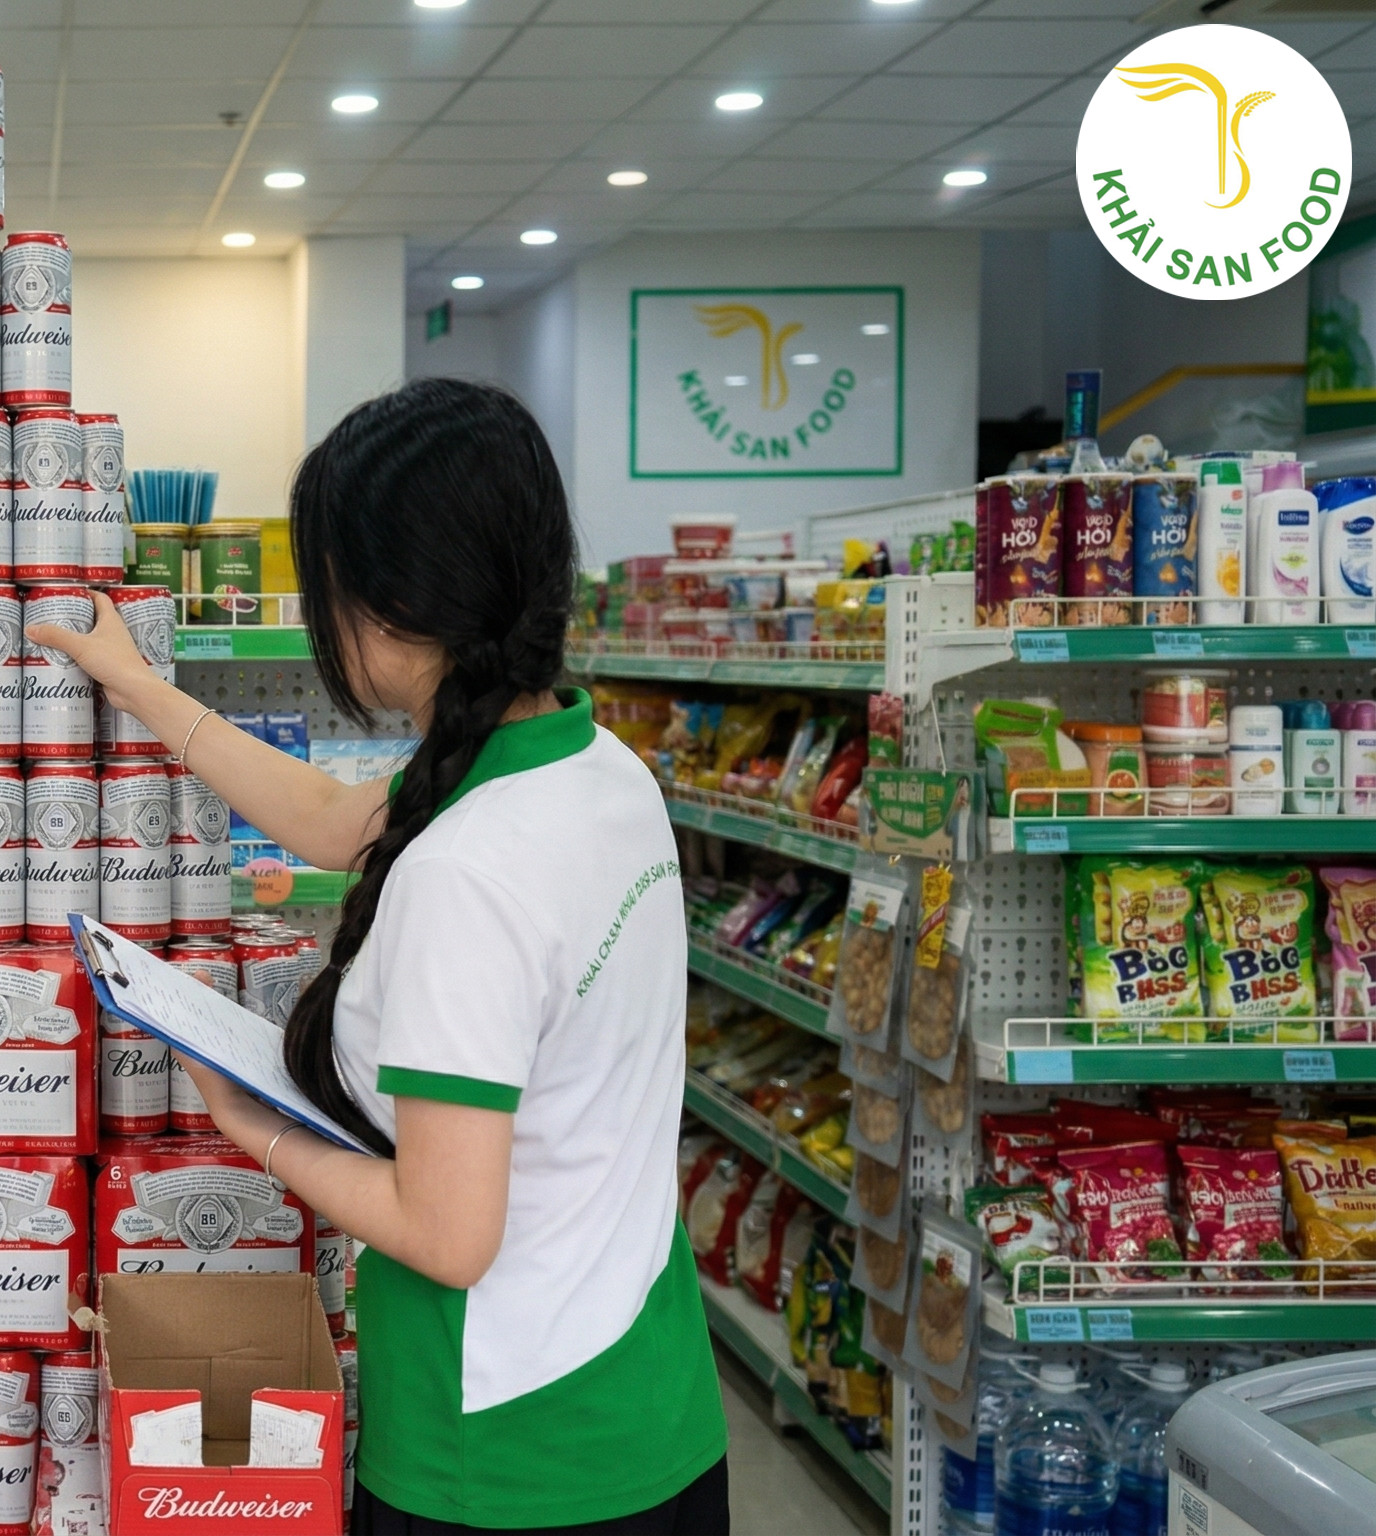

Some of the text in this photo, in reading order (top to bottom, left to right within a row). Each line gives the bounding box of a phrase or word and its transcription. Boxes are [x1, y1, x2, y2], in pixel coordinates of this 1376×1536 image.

[730, 431, 791, 460] SAN
[796, 367, 857, 449] FOOD
[110, 1165, 122, 1181] 6
[138, 1487, 313, 1519] Budweiser
